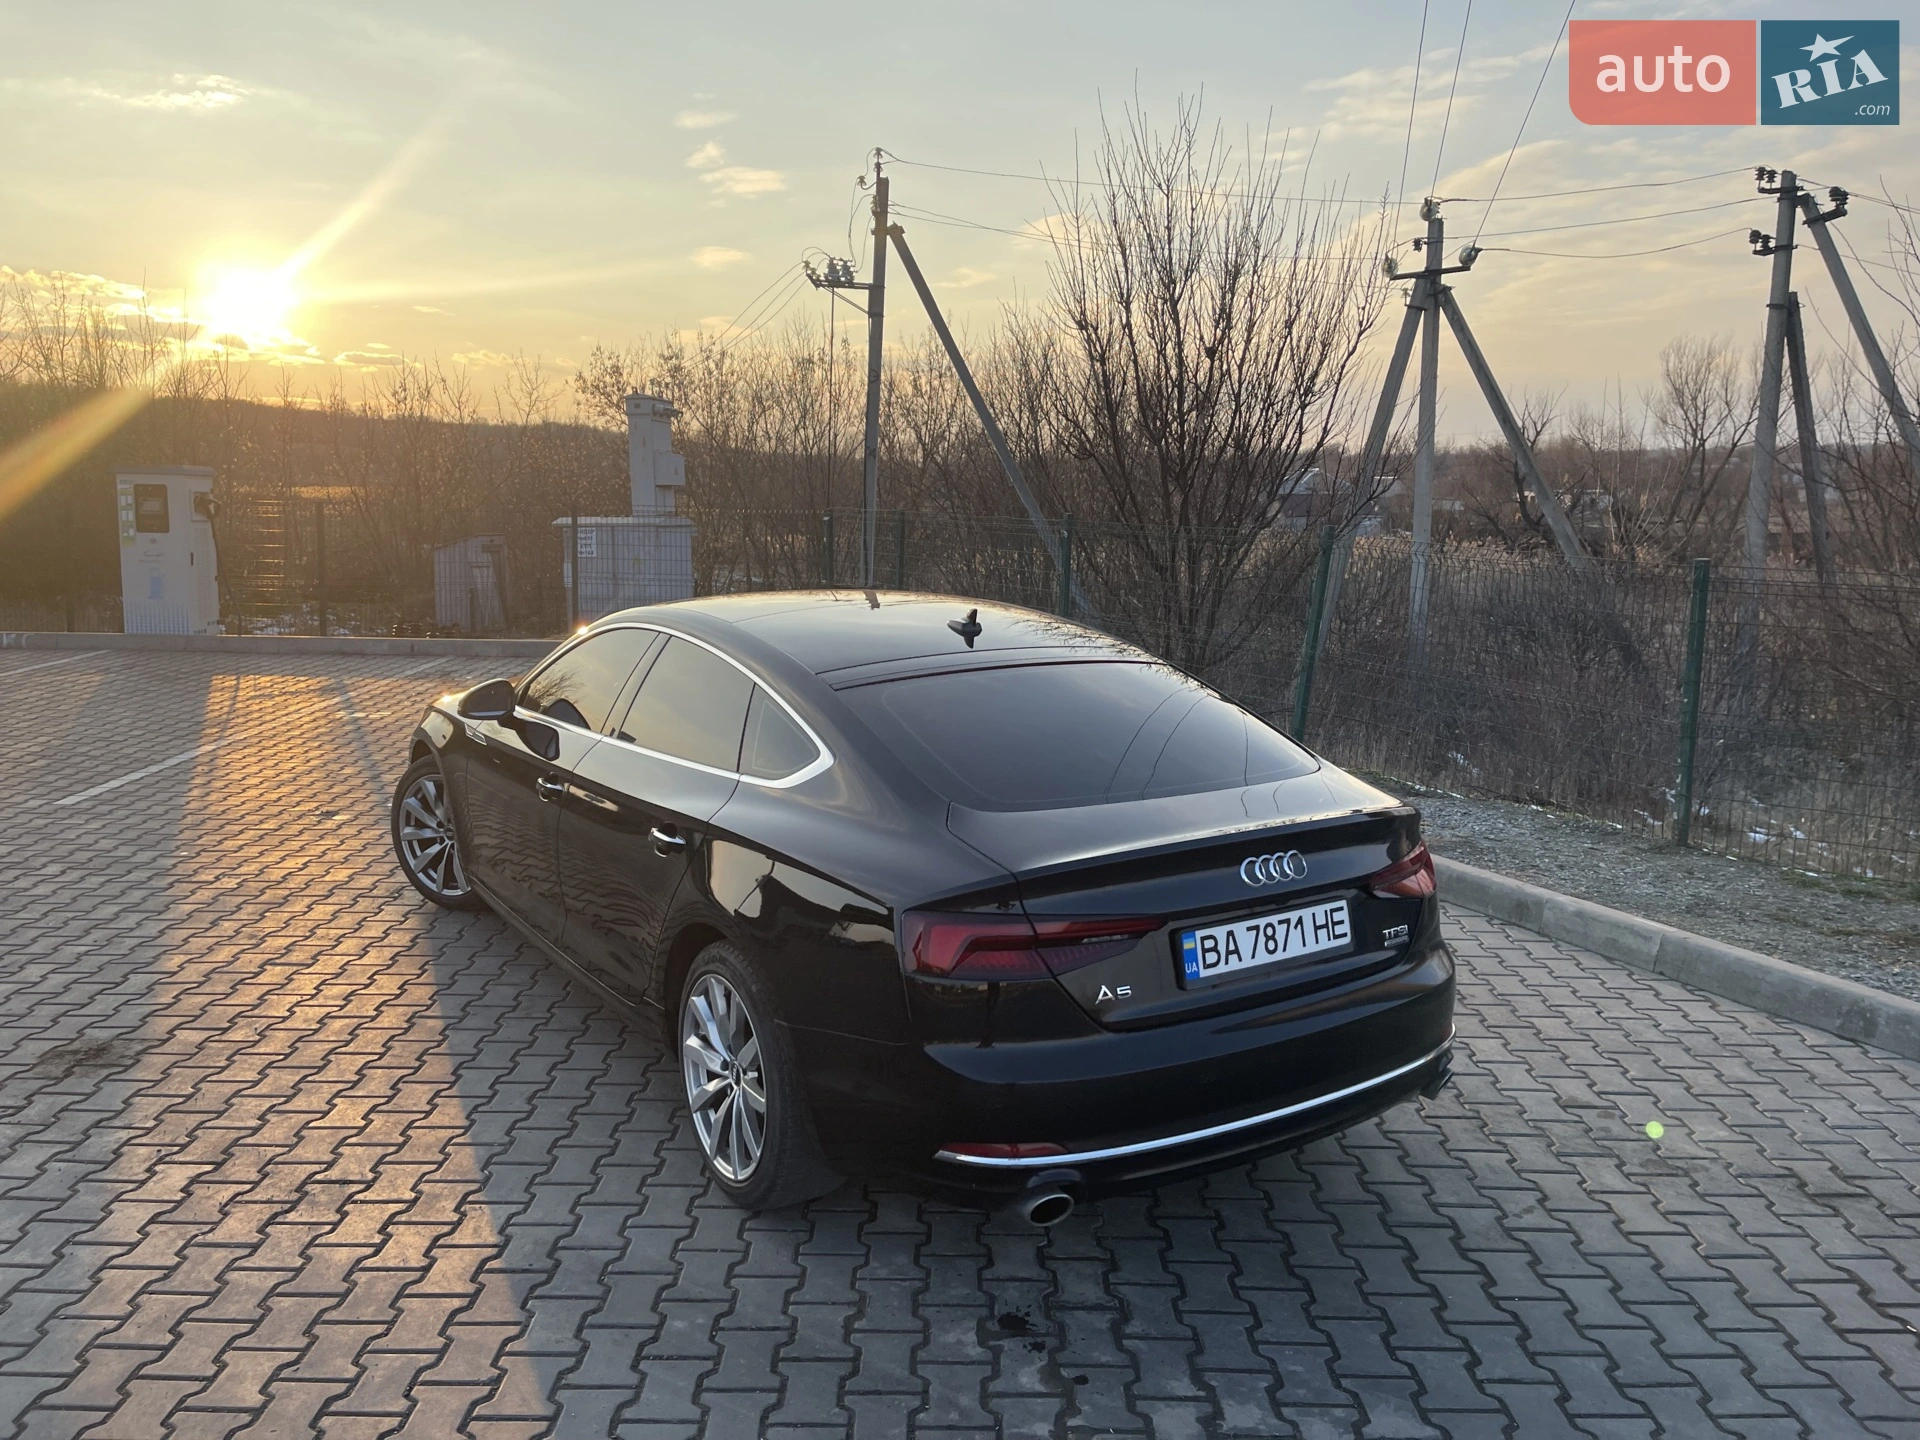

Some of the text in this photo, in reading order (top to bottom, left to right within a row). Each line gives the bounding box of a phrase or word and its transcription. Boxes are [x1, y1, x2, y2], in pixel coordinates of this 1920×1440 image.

[1200, 906, 1348, 970] BA 7871 HE
[1382, 924, 1408, 939] TFSI
[1185, 962, 1198, 973] UA
[1095, 984, 1132, 1005] A5
